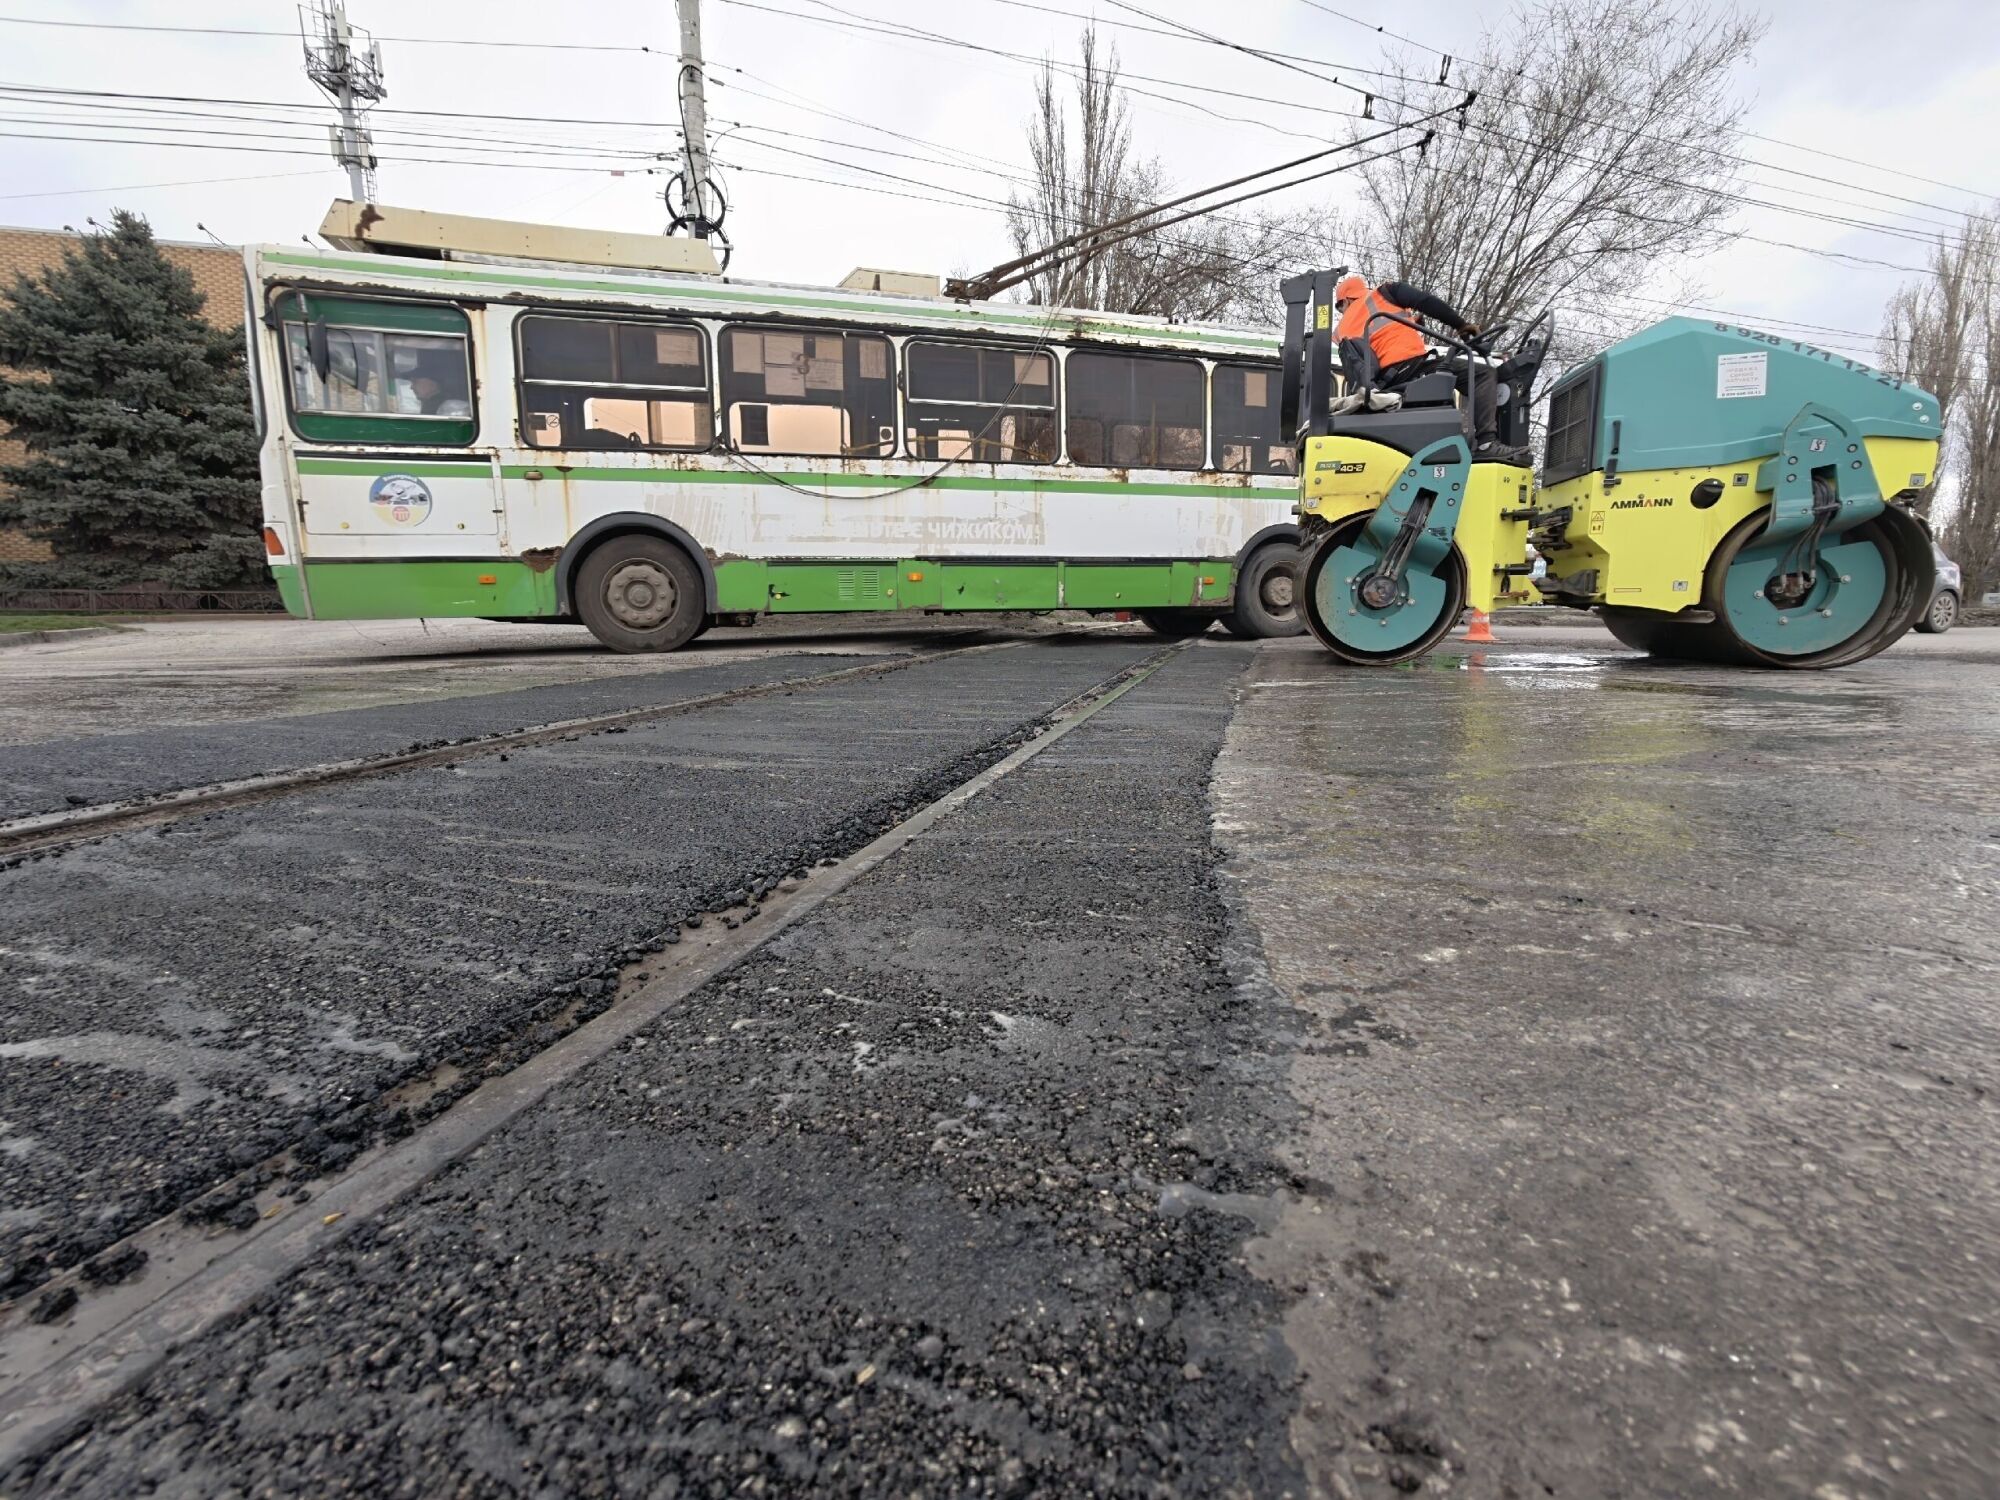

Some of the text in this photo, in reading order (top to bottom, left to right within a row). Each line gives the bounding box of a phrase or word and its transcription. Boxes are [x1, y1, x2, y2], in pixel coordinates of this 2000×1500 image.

[1715, 323, 1902, 391] 8 928 171 12 21
[1340, 464, 1364, 473] 40-2
[1610, 498, 1674, 509] AMMANN
